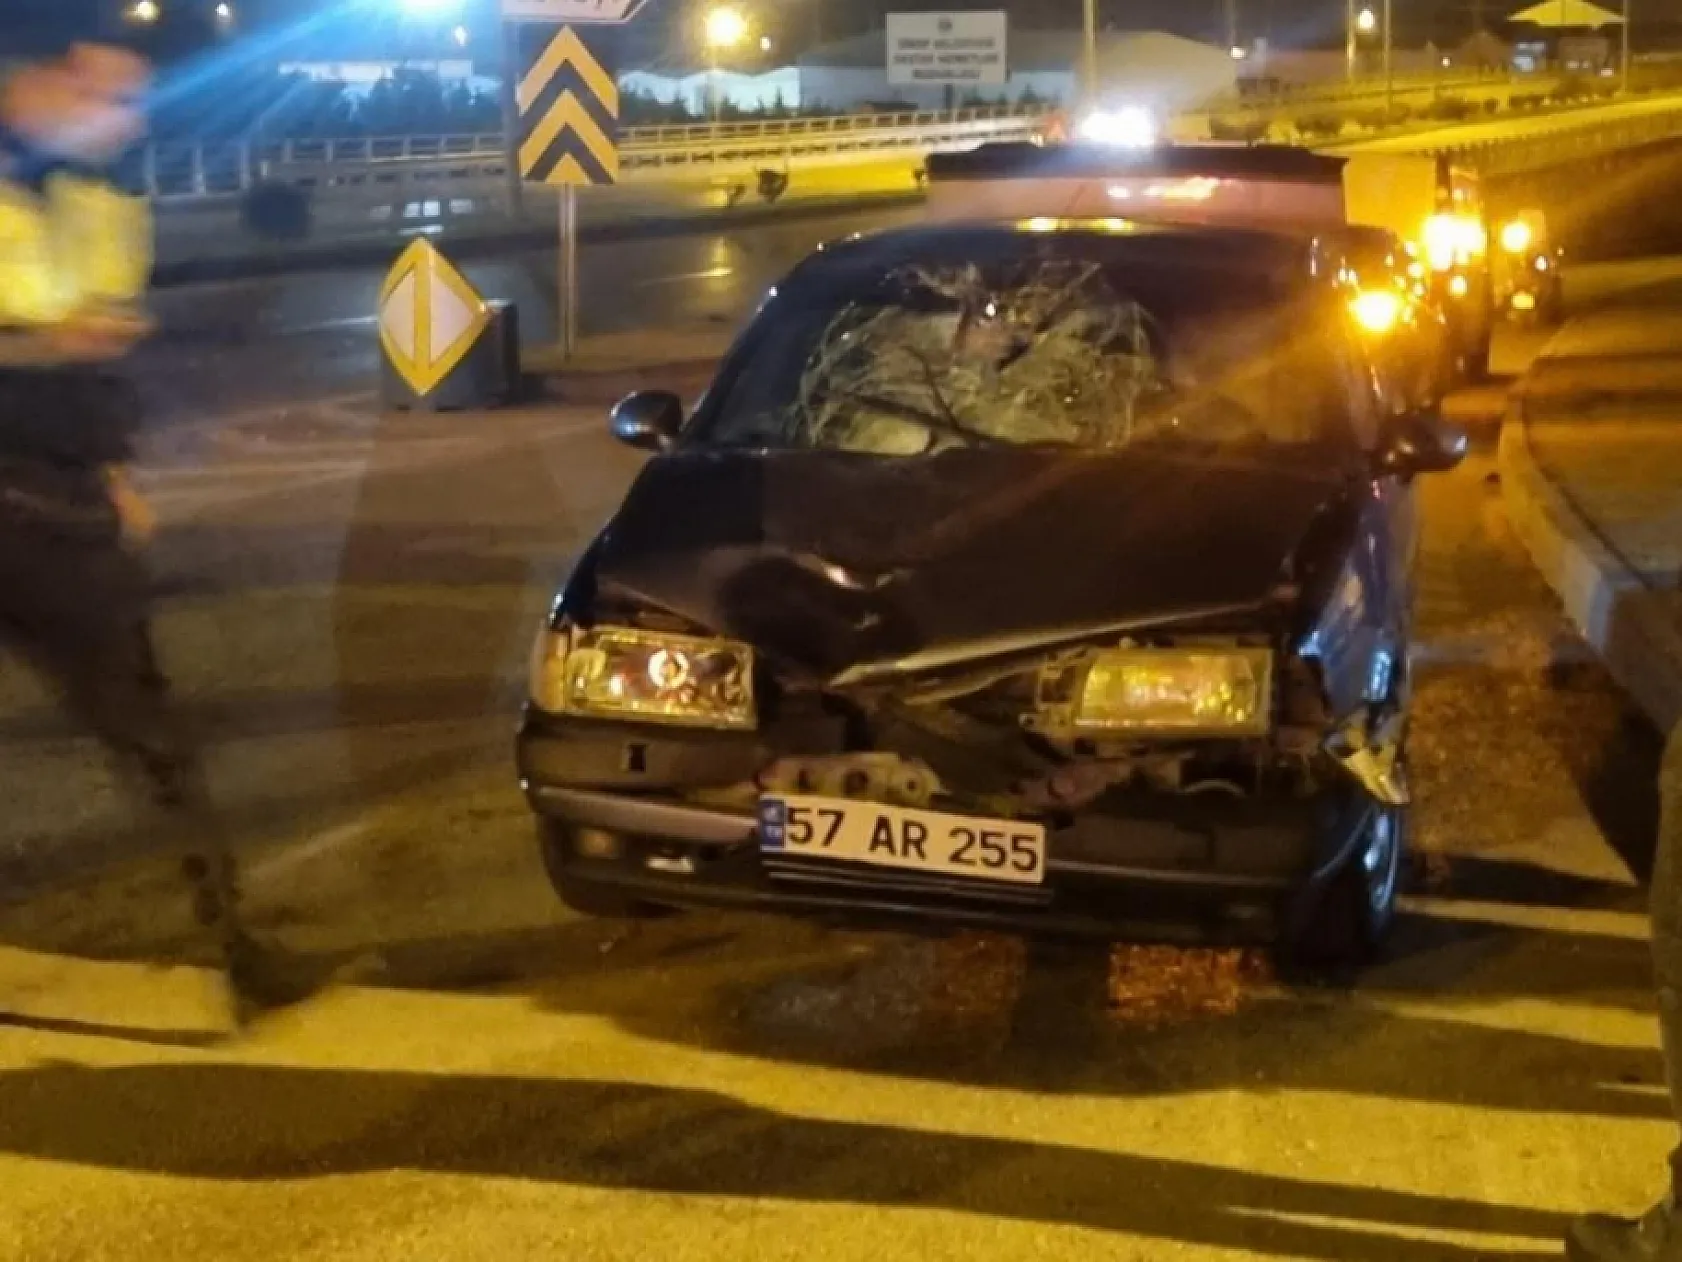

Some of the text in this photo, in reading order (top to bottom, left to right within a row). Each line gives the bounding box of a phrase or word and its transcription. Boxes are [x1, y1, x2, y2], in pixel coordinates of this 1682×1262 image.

[787, 807, 1038, 872] 57 AR 255
